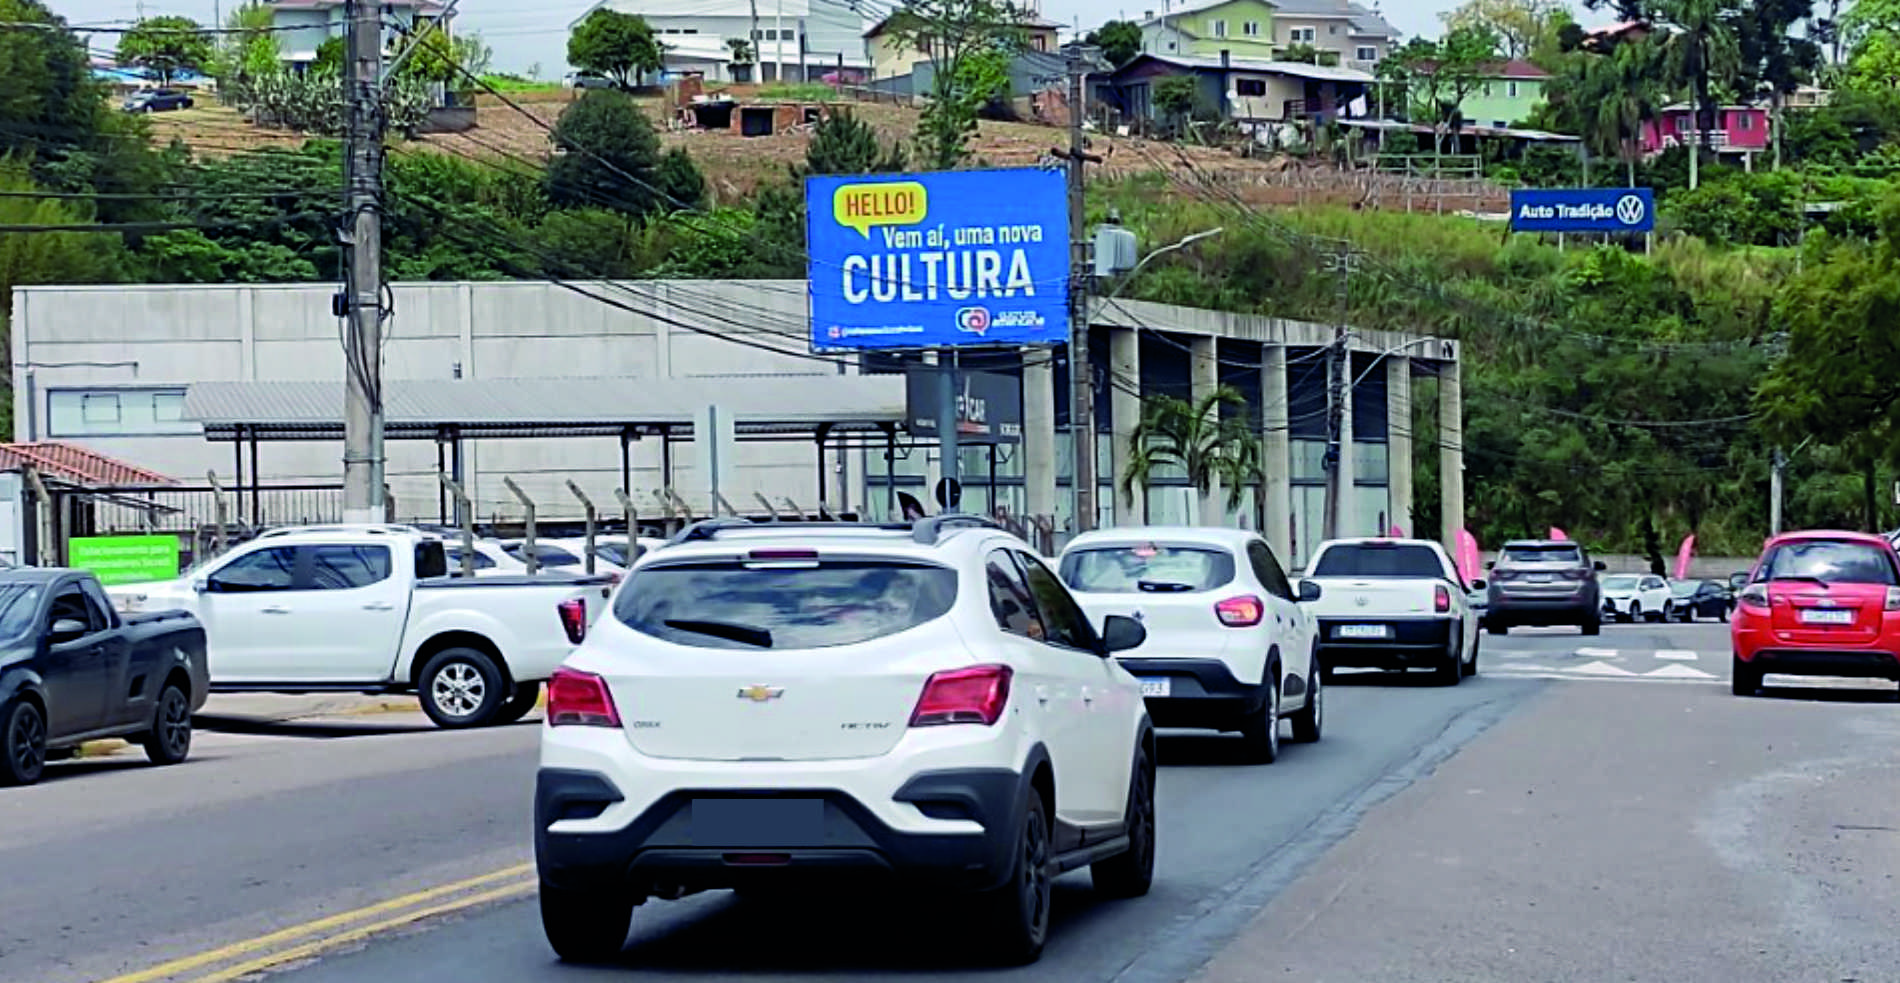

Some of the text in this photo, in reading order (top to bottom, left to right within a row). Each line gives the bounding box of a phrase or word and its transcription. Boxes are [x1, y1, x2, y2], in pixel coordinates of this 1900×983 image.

[846, 191, 915, 217] HELLO!
[1519, 203, 1614, 221] Auto Tradição
[883, 223, 1043, 250] Vem aí, uma nova
[842, 248, 1036, 304] CULTURA
